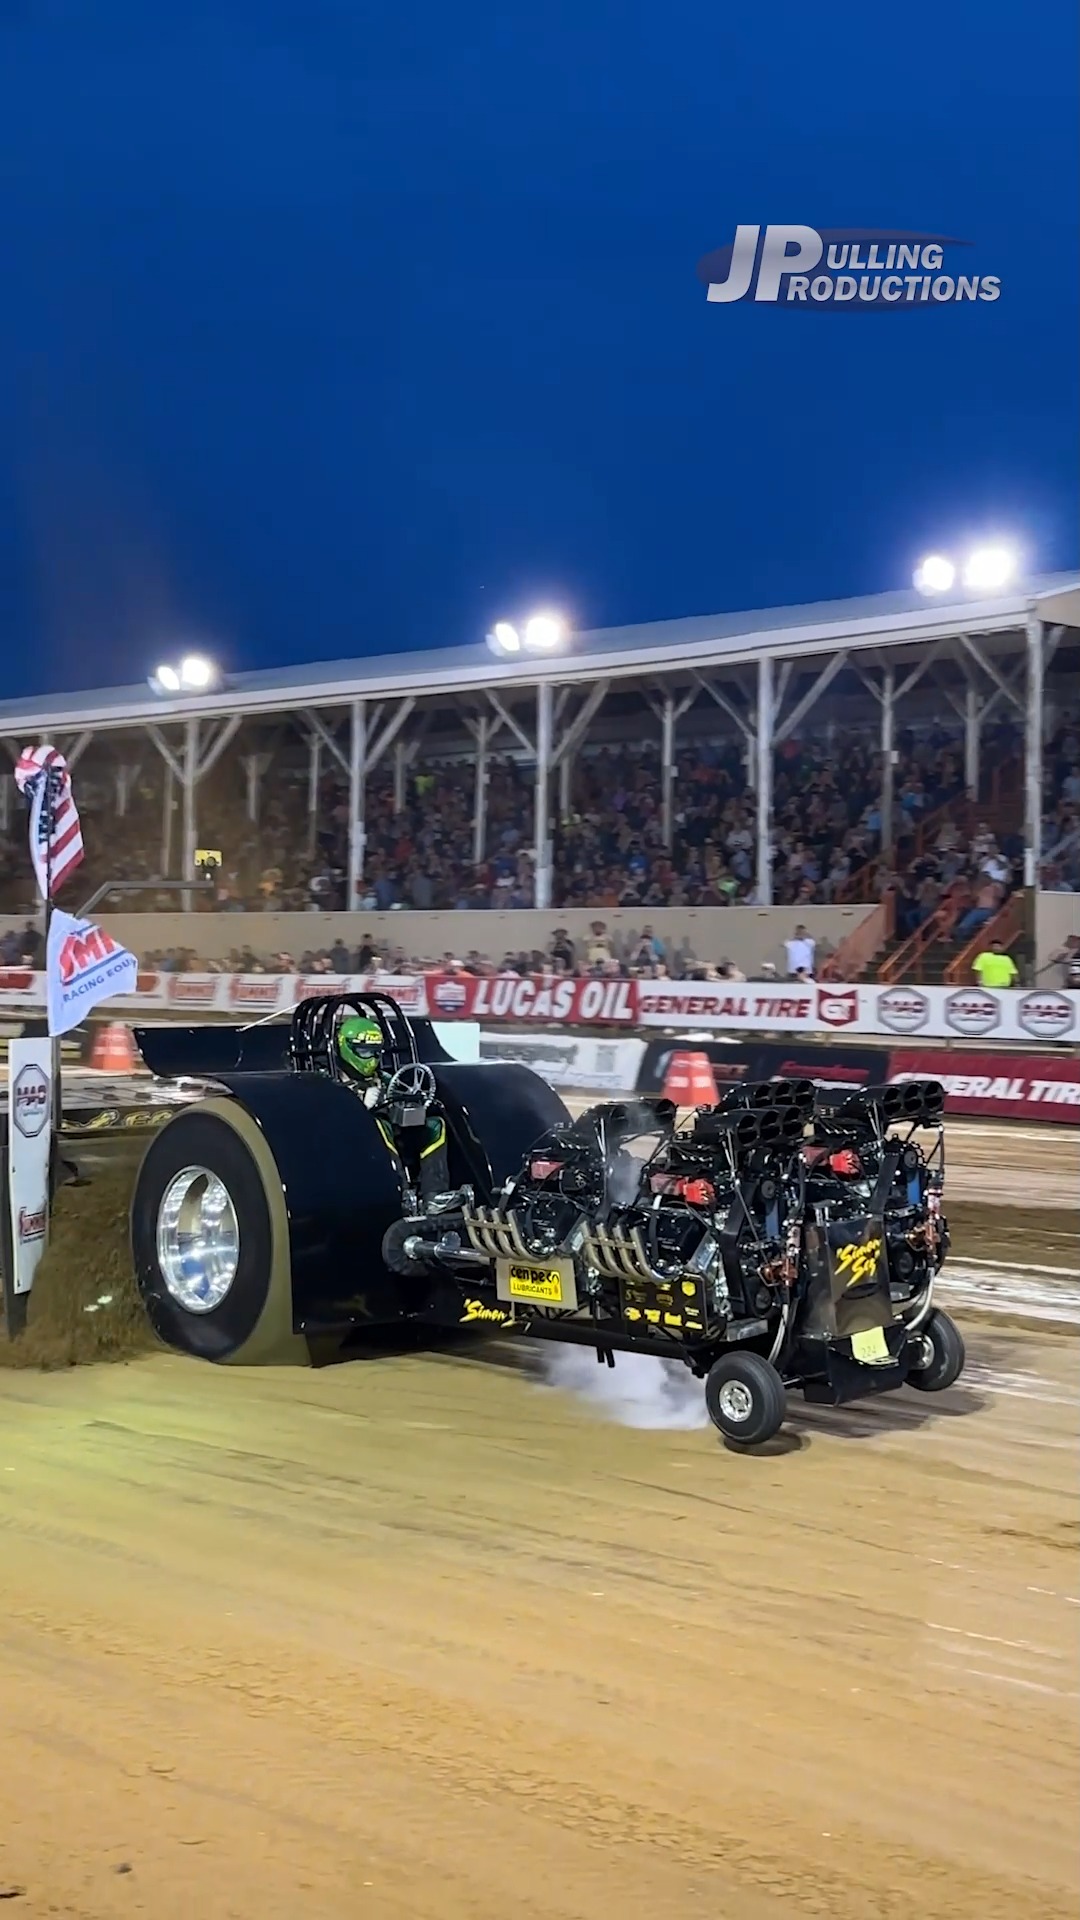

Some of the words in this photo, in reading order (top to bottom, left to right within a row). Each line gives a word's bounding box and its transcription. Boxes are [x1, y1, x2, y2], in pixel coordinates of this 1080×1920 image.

[62, 975, 105, 1003] RACING
[472, 980, 577, 1018] LUCAS
[580, 981, 633, 1020] OIL
[640, 995, 751, 1017] GENERAL
[755, 998, 812, 1019] TIRE
[513, 1283, 553, 1296] LUBRICANTS
